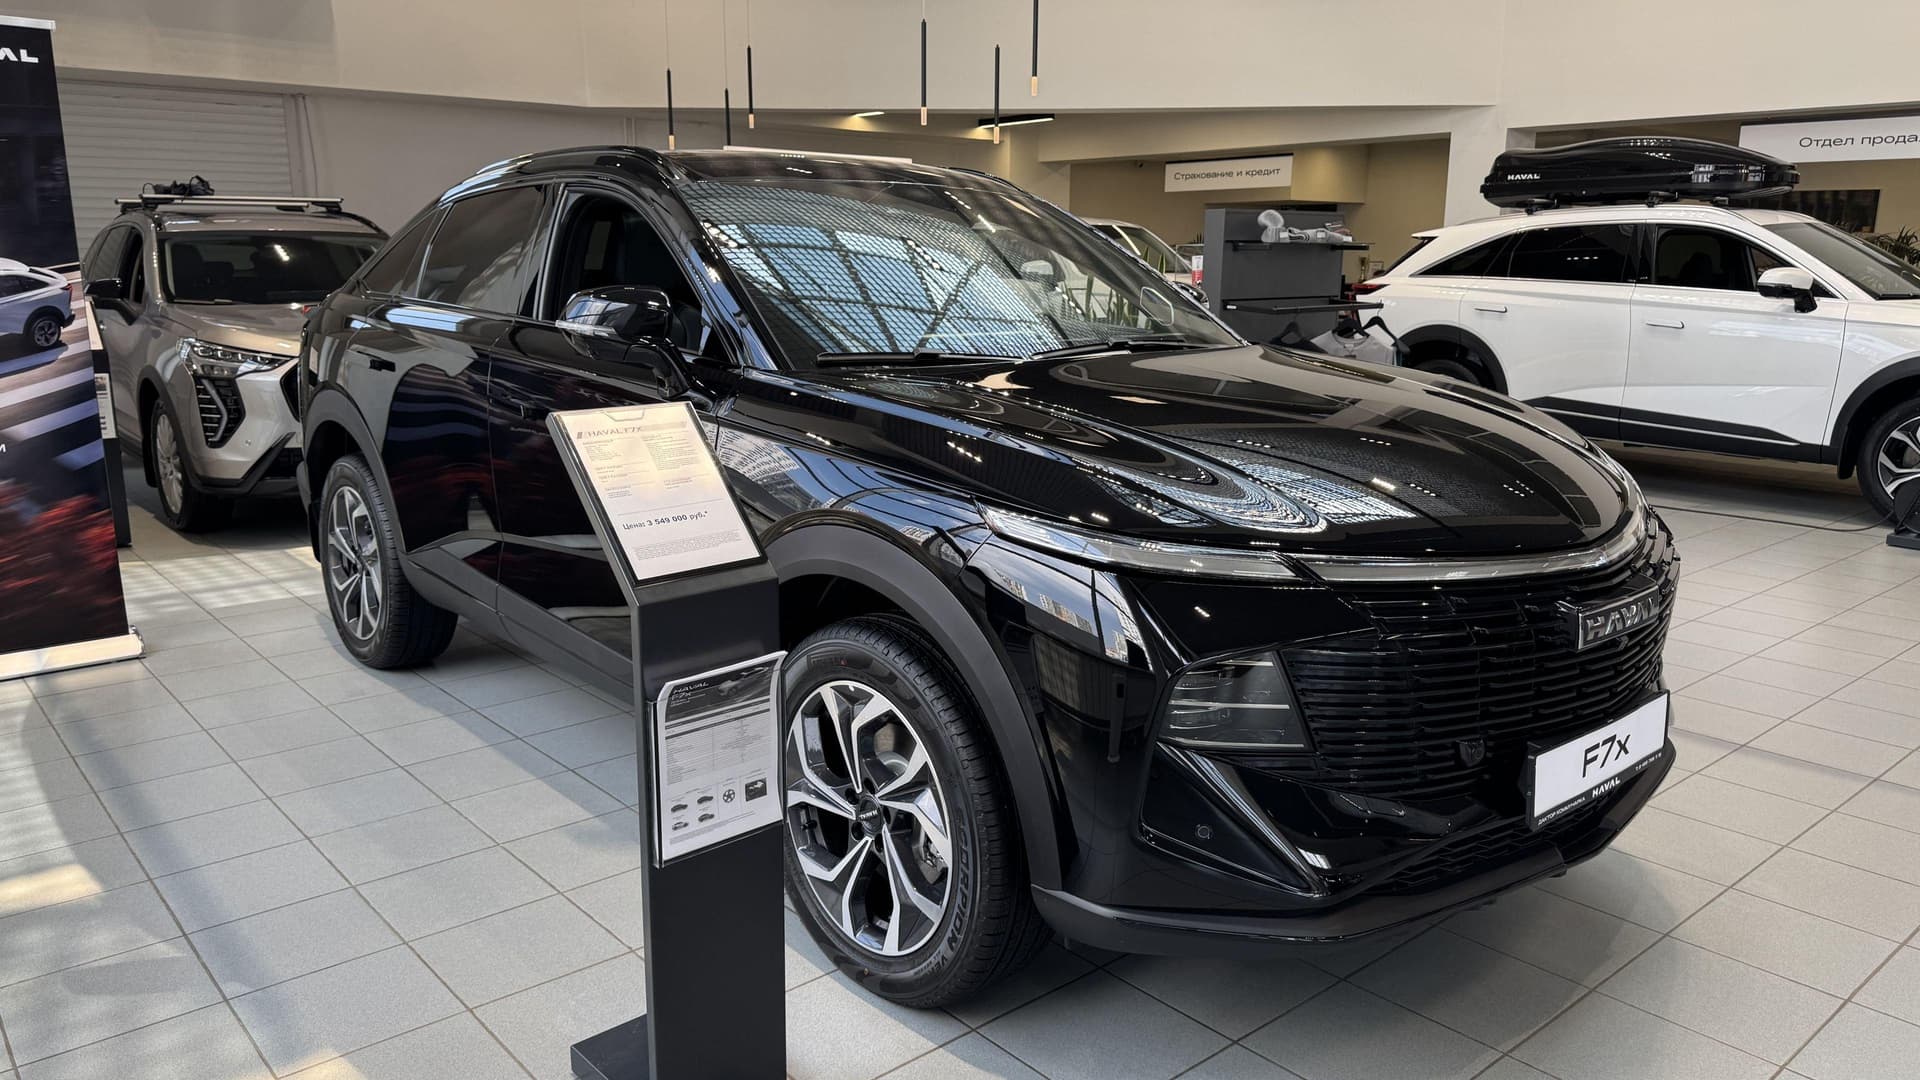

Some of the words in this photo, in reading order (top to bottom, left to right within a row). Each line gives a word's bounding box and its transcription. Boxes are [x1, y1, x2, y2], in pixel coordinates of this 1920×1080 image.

[1799, 137, 1855, 148] Отдел
[1860, 134, 1920, 147] прода
[1174, 170, 1234, 182] Страхование
[1236, 169, 1243, 177] и
[1245, 167, 1281, 178] кредит
[622, 521, 646, 530] Цена:
[654, 517, 671, 525] 549
[671, 514, 688, 522] 000
[1586, 597, 1659, 641] HAVAL
[1582, 734, 1631, 778] F7x
[1592, 777, 1620, 799] HAVAL
